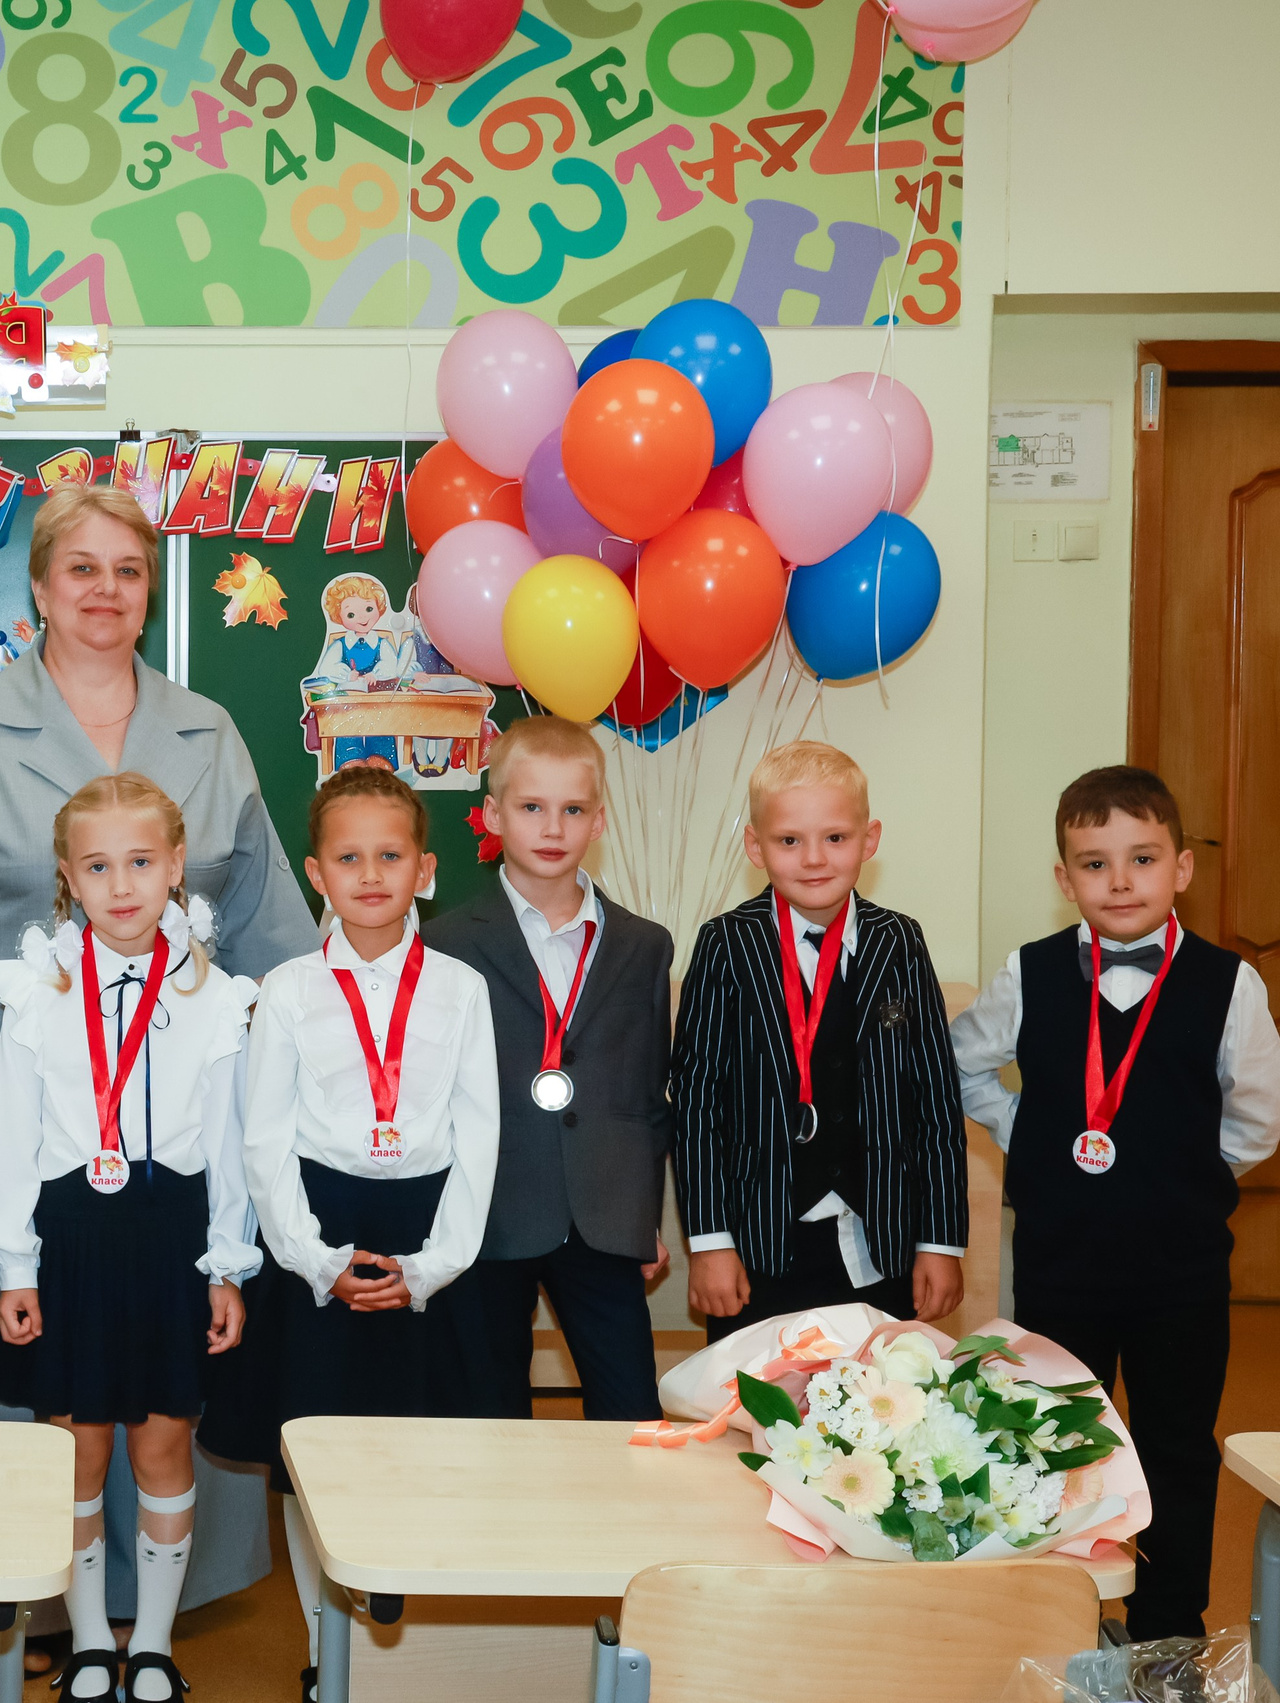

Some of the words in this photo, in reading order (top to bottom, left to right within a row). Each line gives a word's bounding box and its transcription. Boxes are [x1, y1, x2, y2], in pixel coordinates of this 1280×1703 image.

[119, 66, 158, 123] 2
[220, 48, 297, 118] 5
[555, 47, 654, 147] Е
[862, 67, 933, 134] 4
[1, 32, 122, 206] 8
[747, 109, 827, 177] 4
[126, 141, 172, 191] 3
[265, 128, 308, 185] 4
[614, 124, 705, 222] Т
[290, 162, 400, 261] 8
[408, 157, 474, 222] 5
[895, 171, 942, 234] 4
[457, 157, 627, 304] 3
[730, 199, 901, 326] Н
[902, 239, 961, 325] 3
[93, 1155, 102, 1177] 1
[370, 1149, 402, 1159] класс
[371, 1127, 381, 1148] 1
[1076, 1154, 1109, 1169] класс
[1079, 1134, 1089, 1155] 1
[91, 1177, 125, 1187] класс
